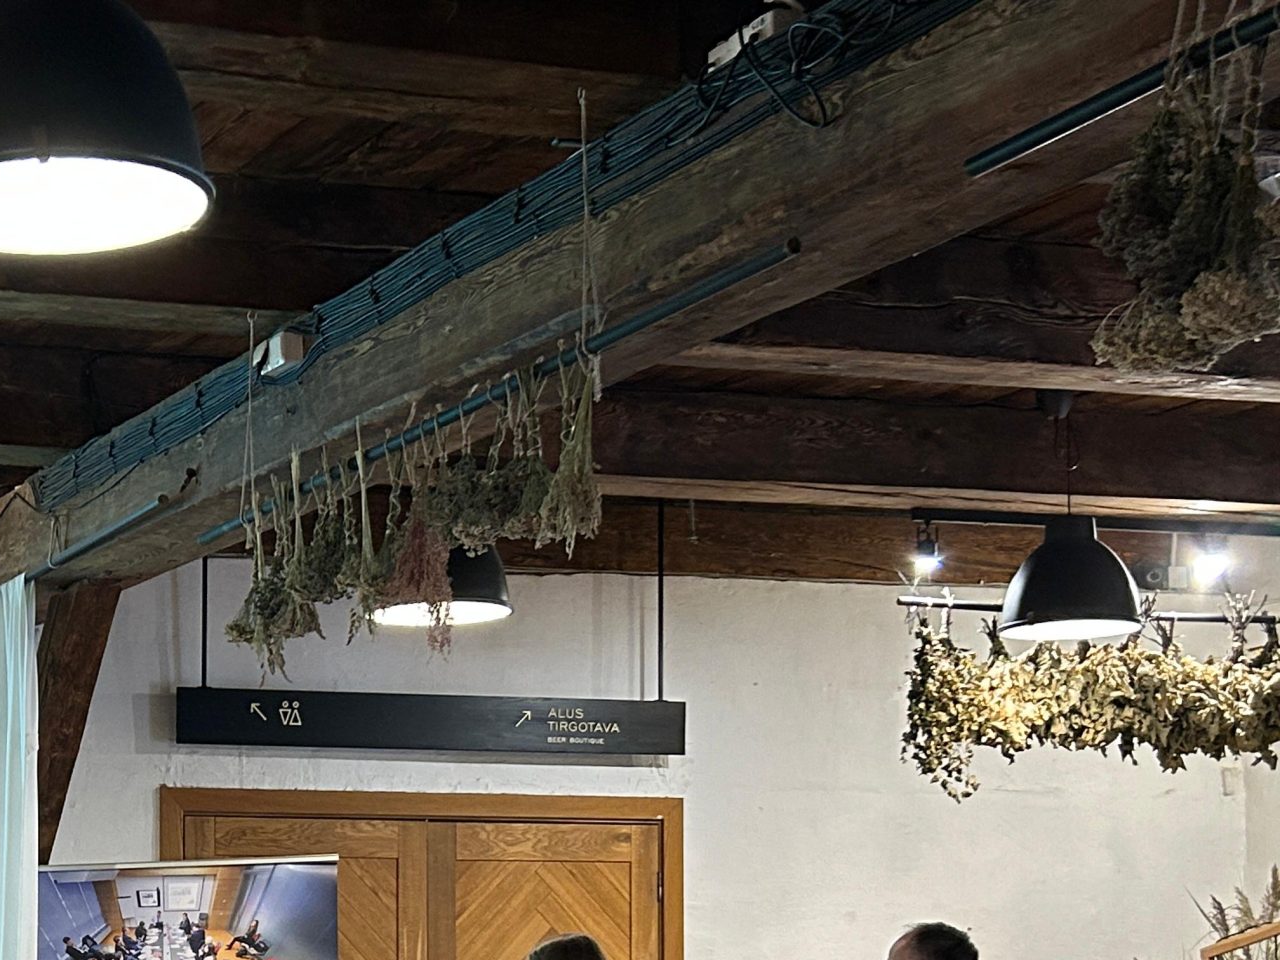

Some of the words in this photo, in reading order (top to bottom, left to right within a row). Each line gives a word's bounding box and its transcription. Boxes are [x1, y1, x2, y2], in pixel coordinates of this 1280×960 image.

[548, 707, 584, 719] ALUS
[547, 721, 620, 733] TIRGOTAVA
[569, 737, 605, 745] BOUTIQUE
